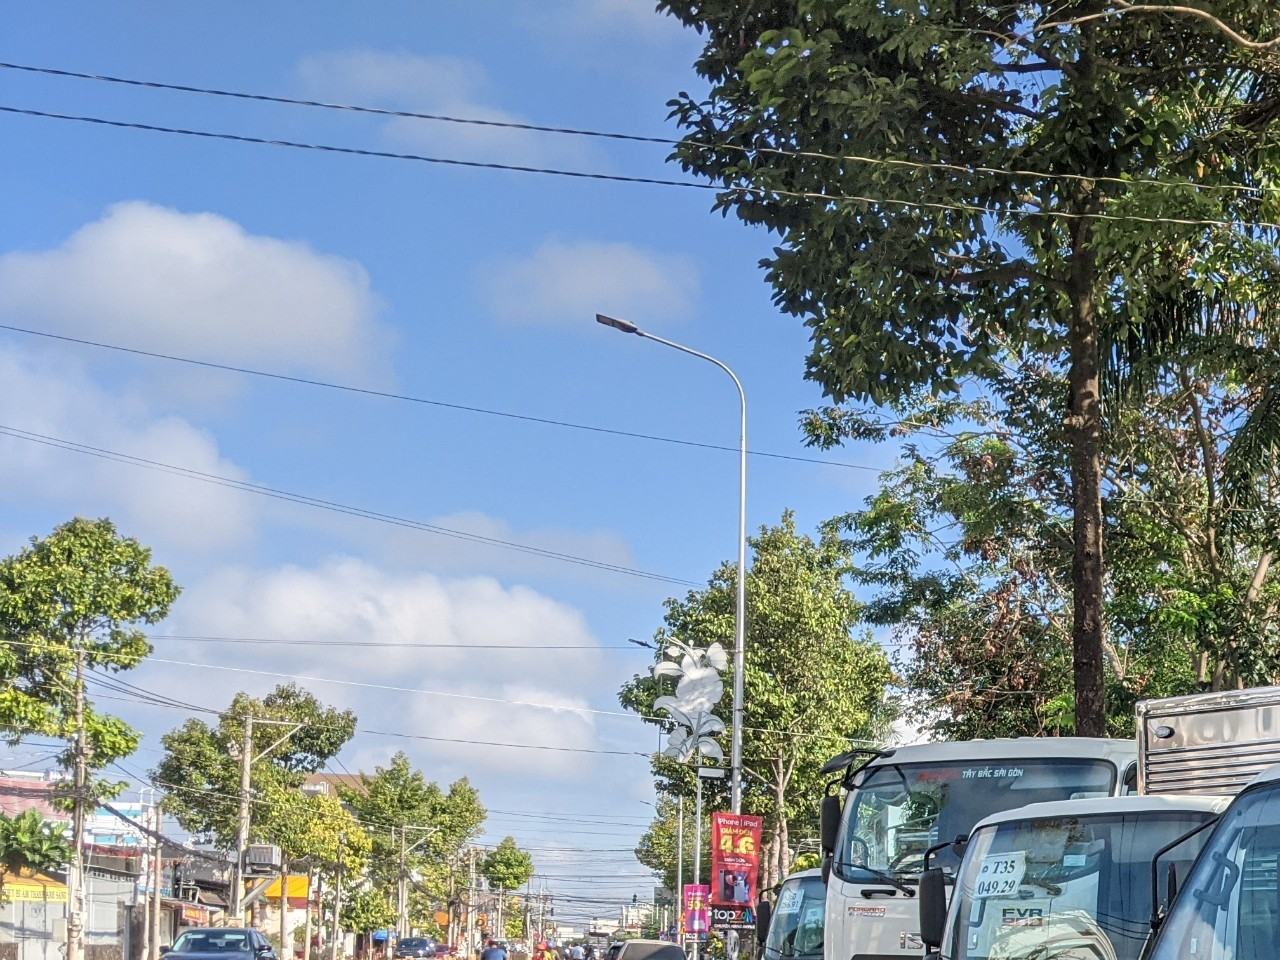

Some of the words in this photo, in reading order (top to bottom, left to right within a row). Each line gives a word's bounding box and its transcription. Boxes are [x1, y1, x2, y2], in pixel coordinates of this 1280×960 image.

[962, 768, 977, 779] TÂY
[1007, 767, 1024, 777] GÒN
[743, 820, 758, 828] iPad
[992, 860, 1016, 874] T35
[977, 880, 1016, 896] 049.29
[1001, 908, 1043, 918] FVR
